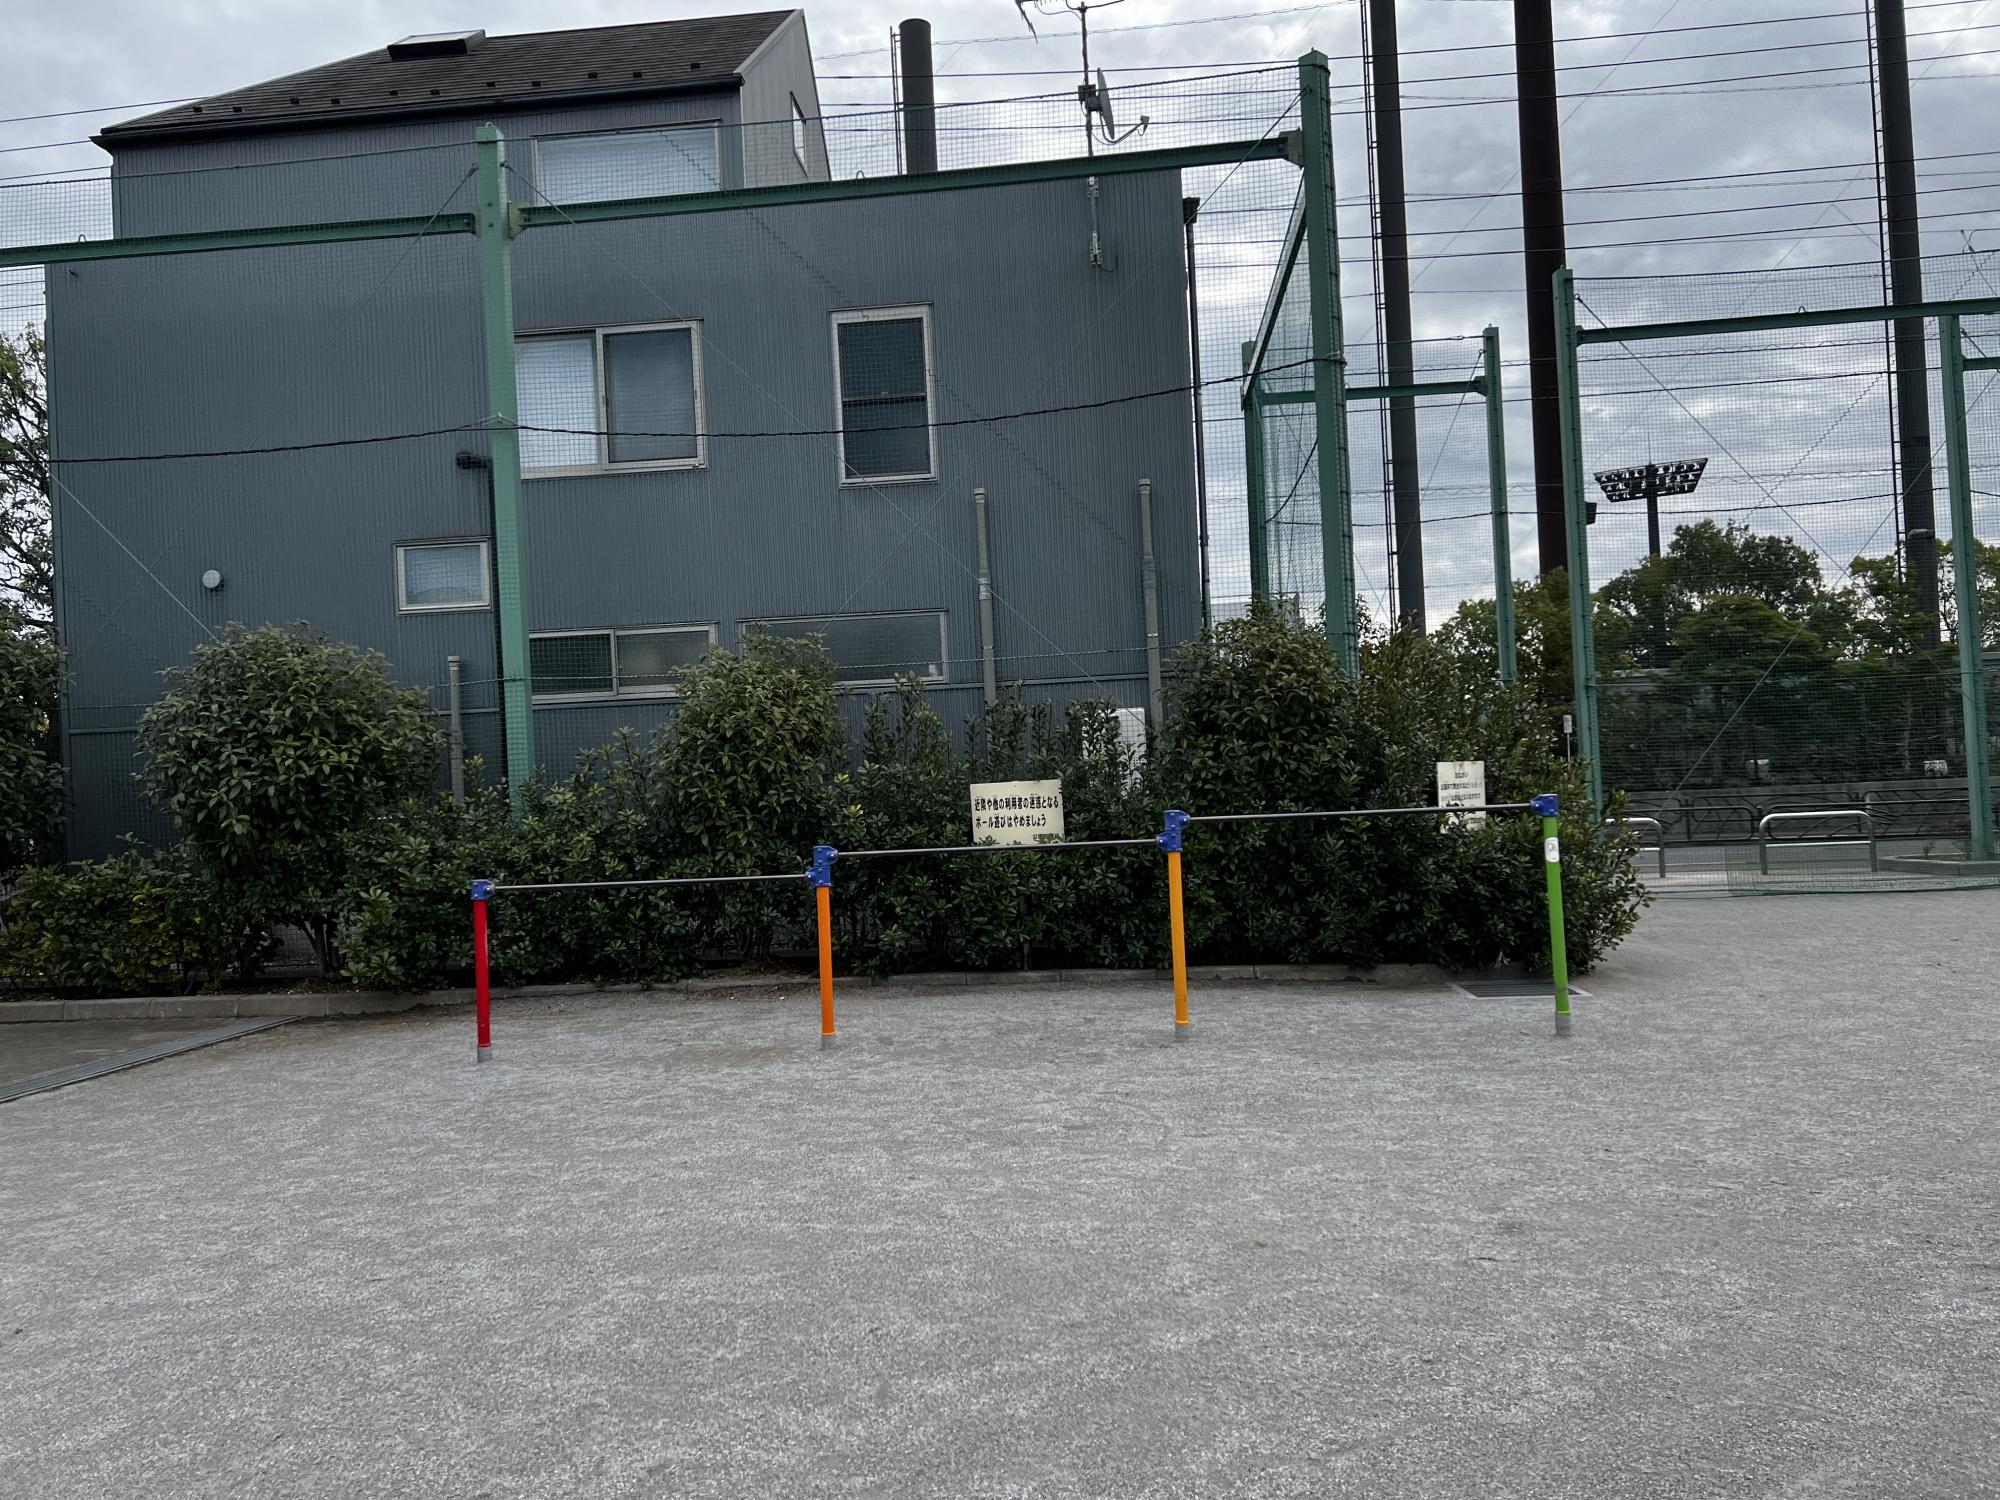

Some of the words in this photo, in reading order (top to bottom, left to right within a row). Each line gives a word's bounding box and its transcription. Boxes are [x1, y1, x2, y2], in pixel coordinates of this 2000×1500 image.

[976, 814, 1046, 829] ボール遊びはやめましょう
